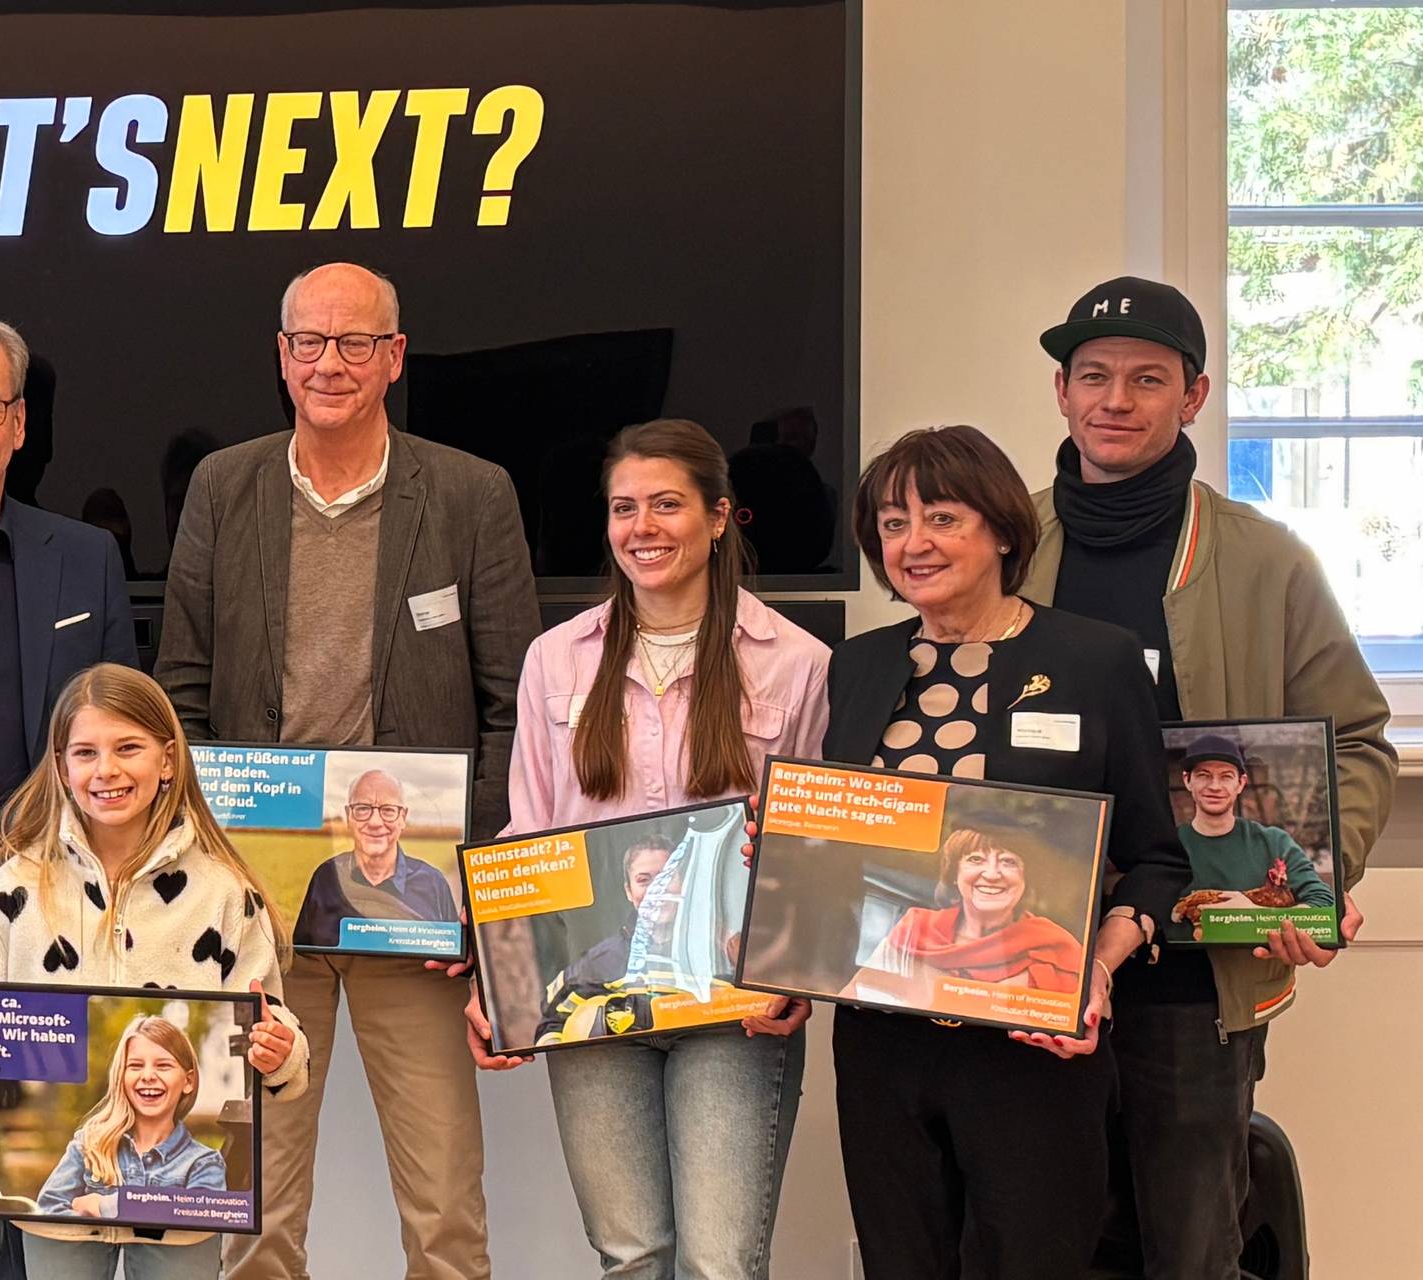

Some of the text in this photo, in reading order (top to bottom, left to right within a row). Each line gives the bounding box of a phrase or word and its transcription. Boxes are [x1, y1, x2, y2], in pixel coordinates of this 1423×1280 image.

[193, 751, 316, 765] Mit den Füßen auf
[225, 766, 270, 778] Boden.
[221, 780, 250, 792] dem
[254, 782, 285, 797] Kopf
[288, 782, 301, 794] in
[775, 768, 904, 794] Bergheim: Wo sich
[215, 795, 257, 808] Cloud.
[772, 784, 930, 814] Fuchs und Tech-Gigant
[769, 800, 897, 826] gute Nacht sagen.
[469, 840, 573, 867] Kleinstadt? Ja.
[473, 856, 576, 884] Klein denken?
[475, 882, 540, 902] Niemals.
[1209, 914, 1255, 924] Bergheim.
[1, 998, 21, 1008] ca.
[3, 1028, 29, 1042] Wir
[31, 1030, 76, 1044] haben
[127, 1192, 171, 1203] Bergheim.
[195, 1196, 205, 1204] of
